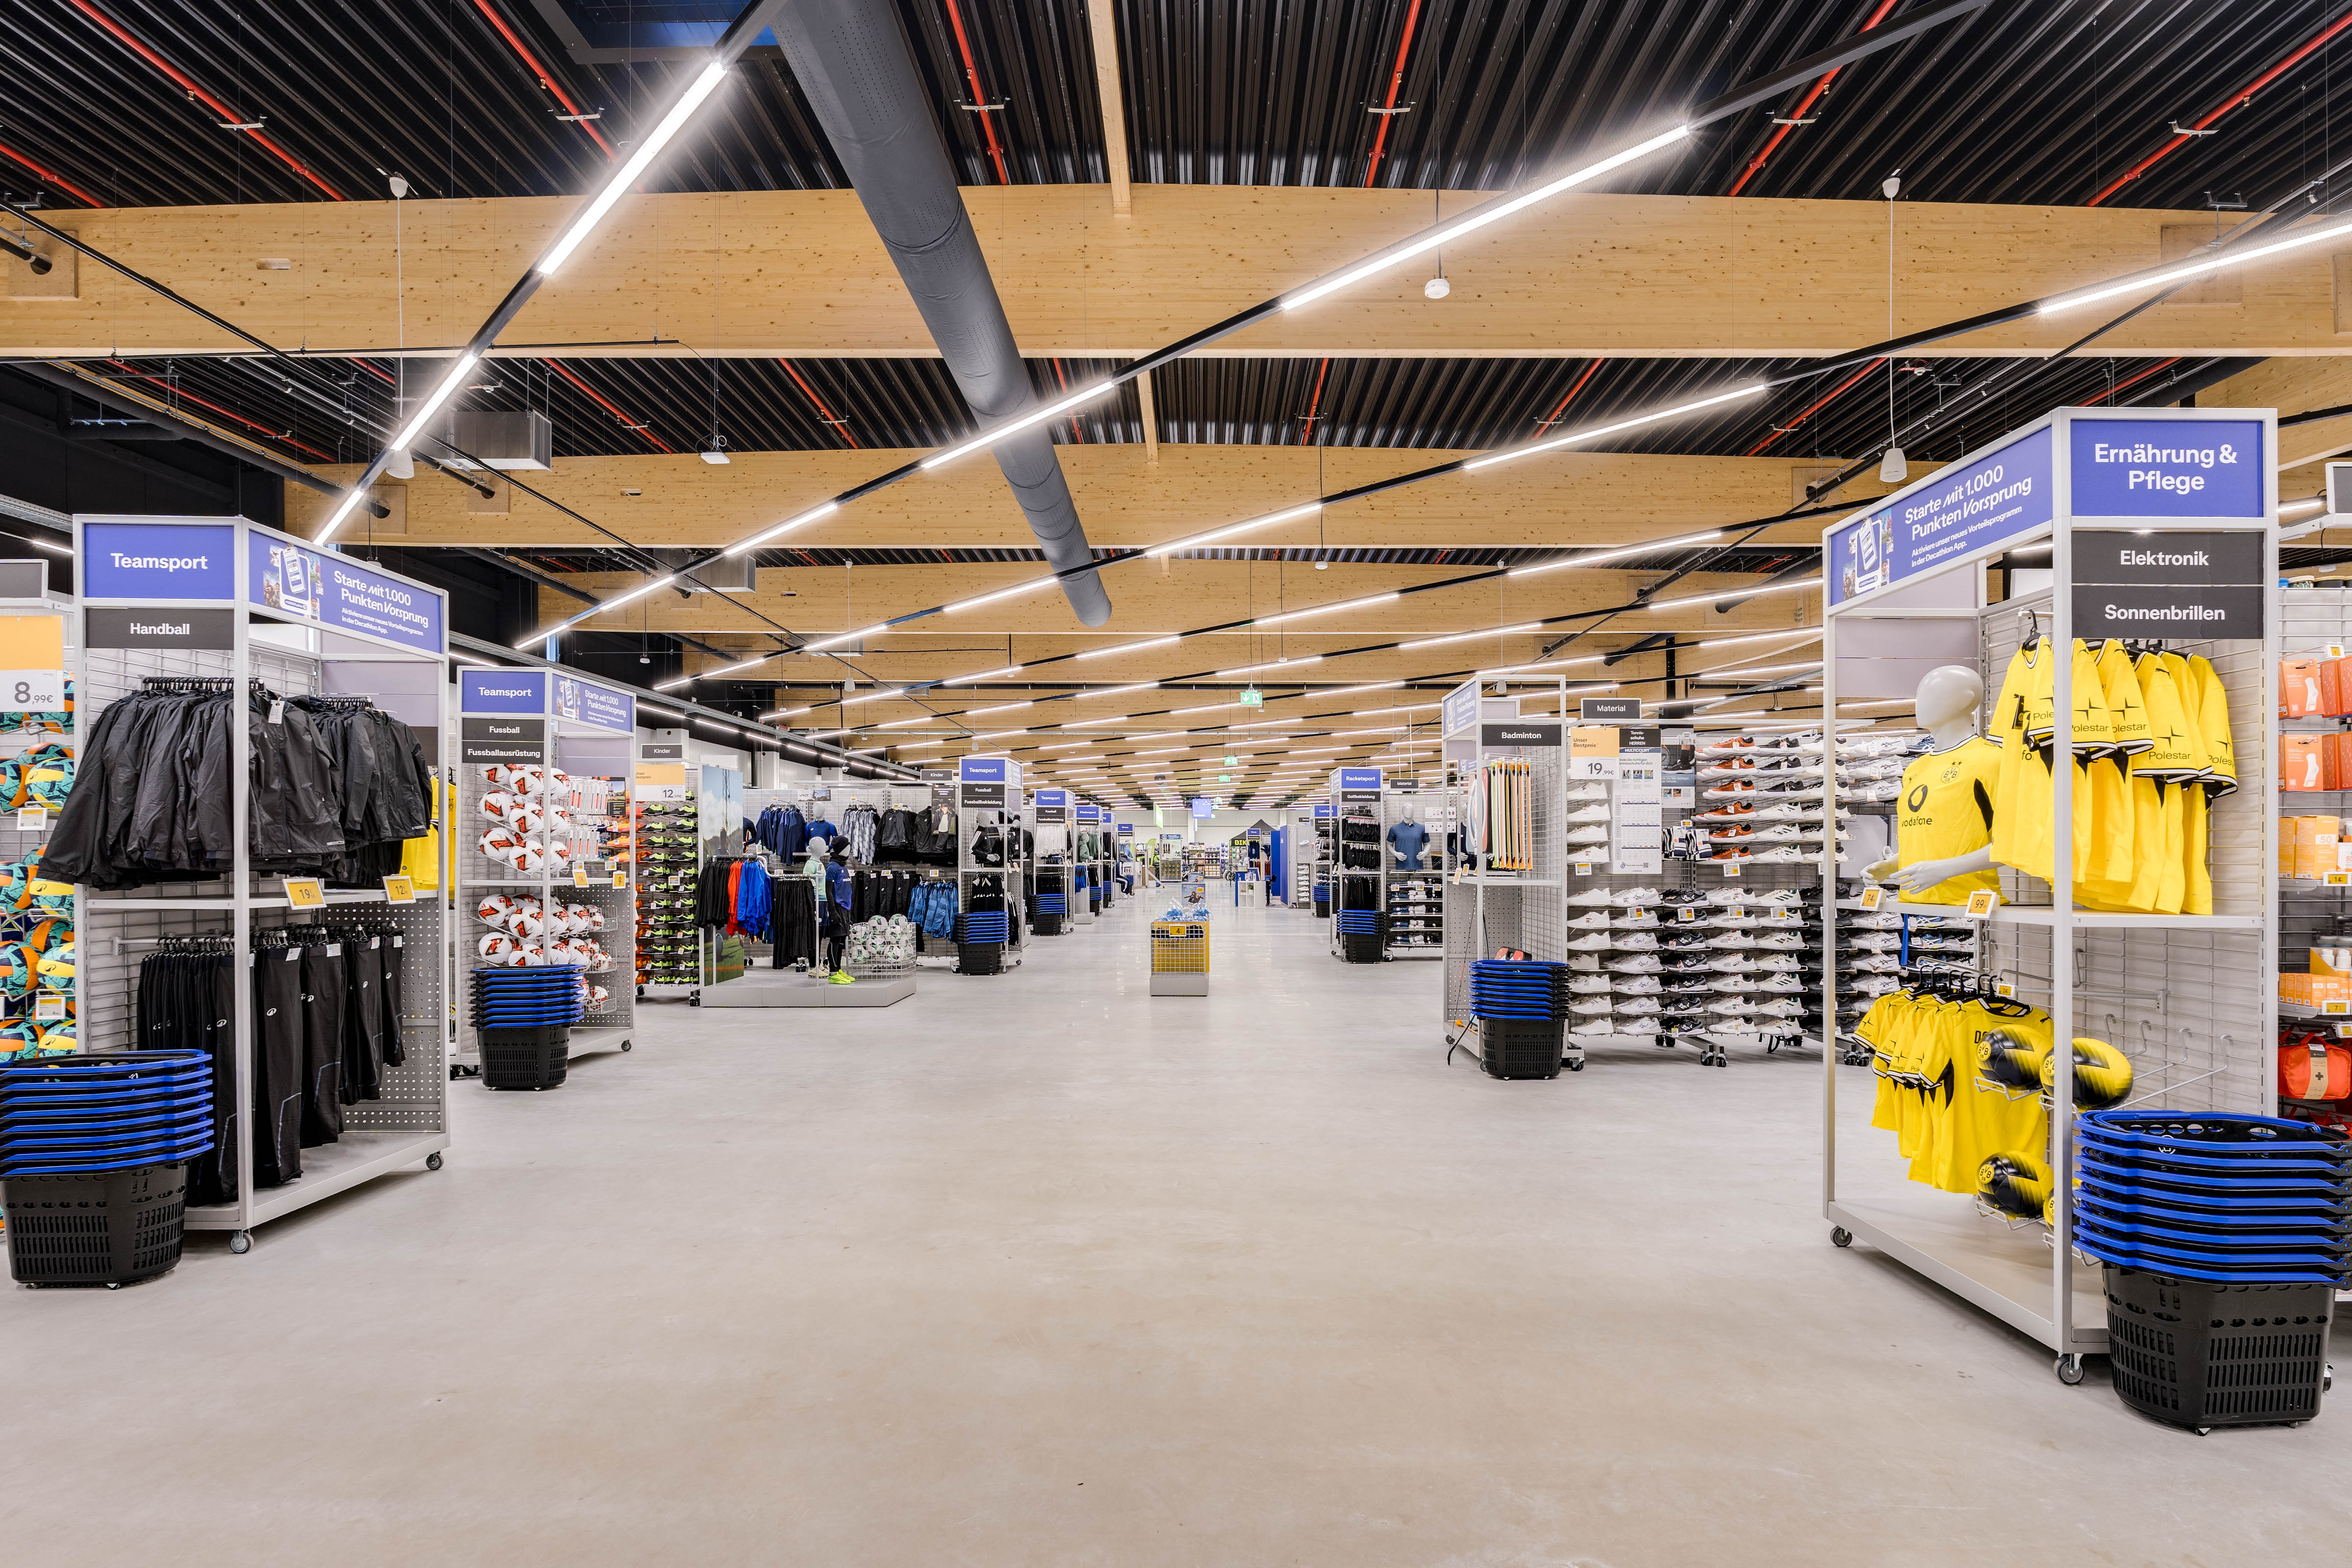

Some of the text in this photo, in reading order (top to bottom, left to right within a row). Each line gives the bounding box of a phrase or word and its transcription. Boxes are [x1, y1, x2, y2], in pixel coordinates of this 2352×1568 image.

[2095, 443, 2238, 468] Ernährung &
[2129, 470, 2205, 495] Pflege
[1905, 498, 1941, 524] Starte
[1965, 465, 2003, 496] 1.000
[1912, 477, 2032, 541] Punkten Vorsprung
[1911, 506, 2022, 557] Aktiviere unser neues Vorteilsprogramm
[1916, 556, 1925, 565] der
[1926, 546, 1954, 562] Decathlon
[1953, 540, 1967, 551] App.
[2121, 550, 2209, 565] Elektronik
[110, 553, 208, 572] Teamsport
[334, 570, 367, 591] Starte
[385, 588, 411, 606] 1.000
[341, 588, 429, 628] Punkten Vorsprung
[2105, 604, 2225, 620] Sonnenbrillen
[342, 607, 363, 619] Aktiviere
[363, 613, 375, 623] unser
[388, 621, 423, 636] Vorteilsprogramm
[355, 619, 377, 631] Decathlon
[130, 623, 190, 635] Handball
[478, 687, 532, 698] Teamsport
[585, 689, 599, 700] Starte
[588, 699, 606, 710] Punkten
[606, 706, 626, 717] Vorsprung
[2033, 712, 2054, 721] Pole
[2072, 724, 2109, 732] olestar
[2112, 723, 2147, 734] olestar
[468, 749, 540, 758] Fussballausrüstung
[2149, 751, 2191, 760] Polestar
[1943, 767, 1958, 778] BVB
[1901, 816, 1932, 827] vodafone
[1978, 1043, 1989, 1055] BVB
[1980, 1166, 1992, 1178] BVB
